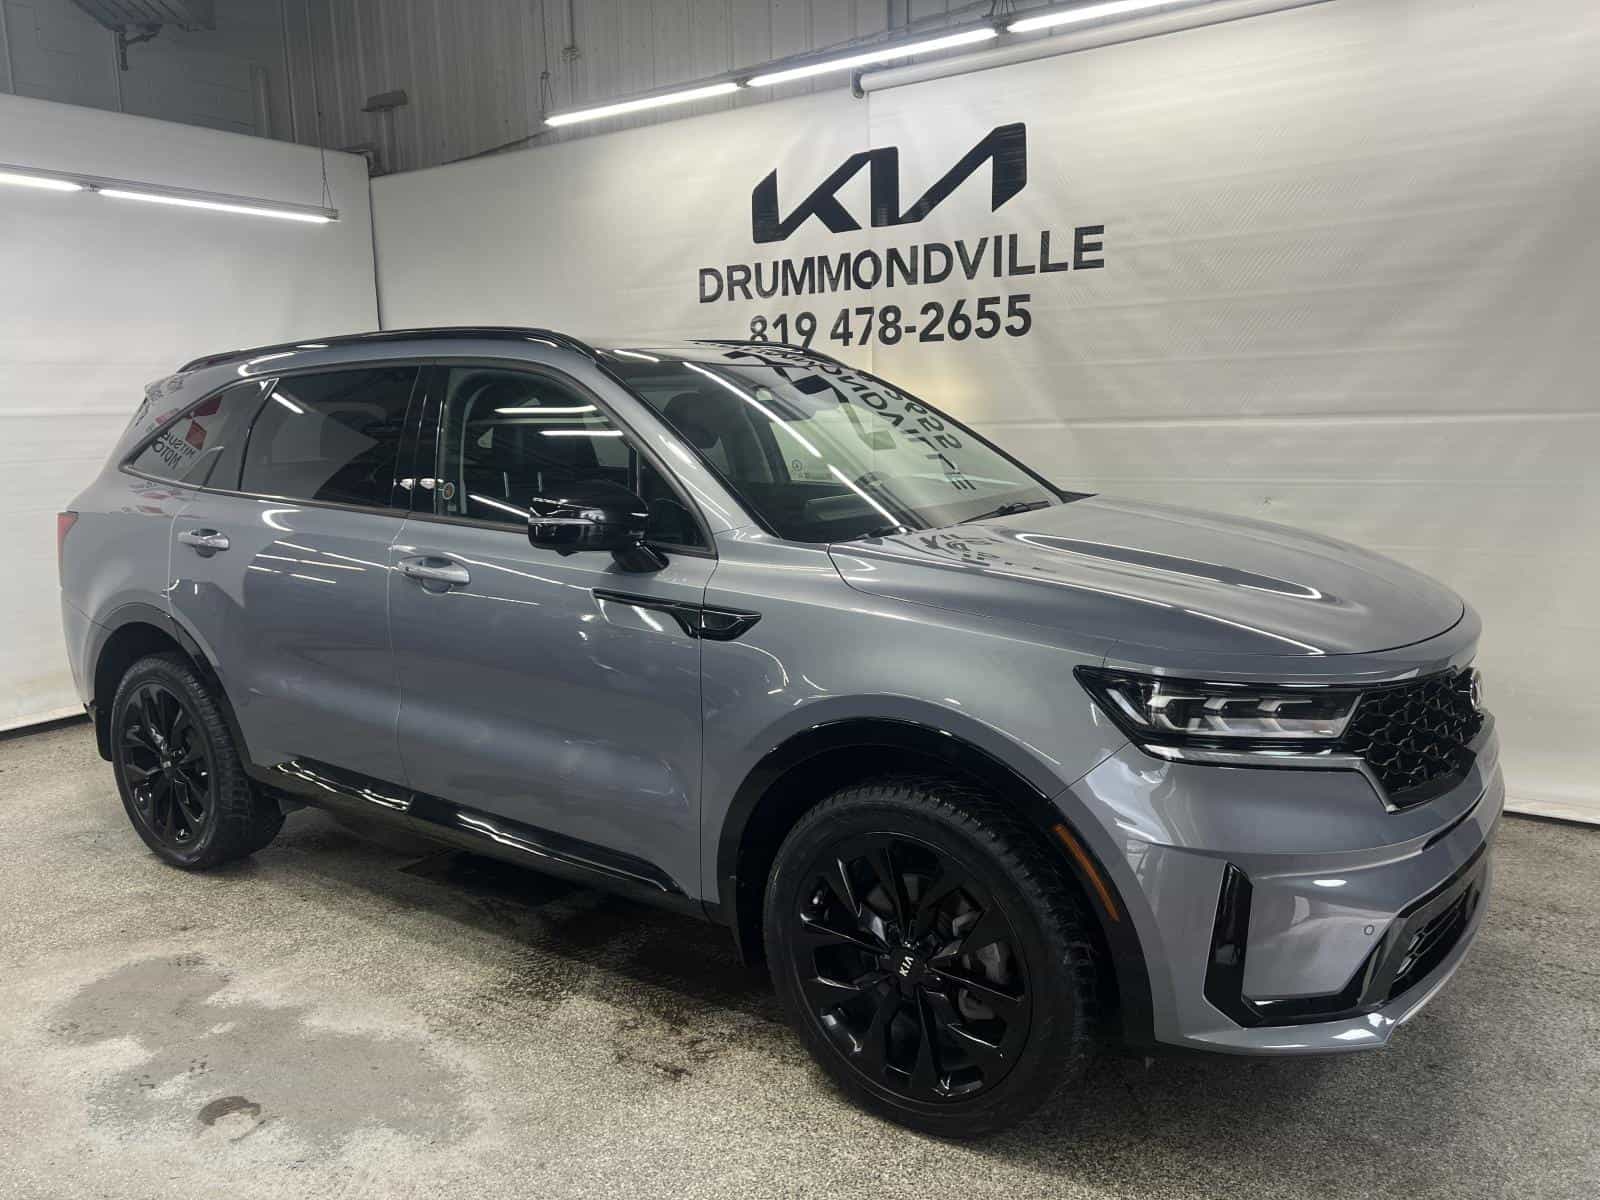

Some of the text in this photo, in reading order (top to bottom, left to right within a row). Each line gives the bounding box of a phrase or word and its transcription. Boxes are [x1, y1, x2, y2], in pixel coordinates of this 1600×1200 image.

[752, 122, 1027, 244] KIA
[700, 224, 1105, 303] DRUMMONDVILLE
[750, 293, 1032, 349] 819 478-2655
